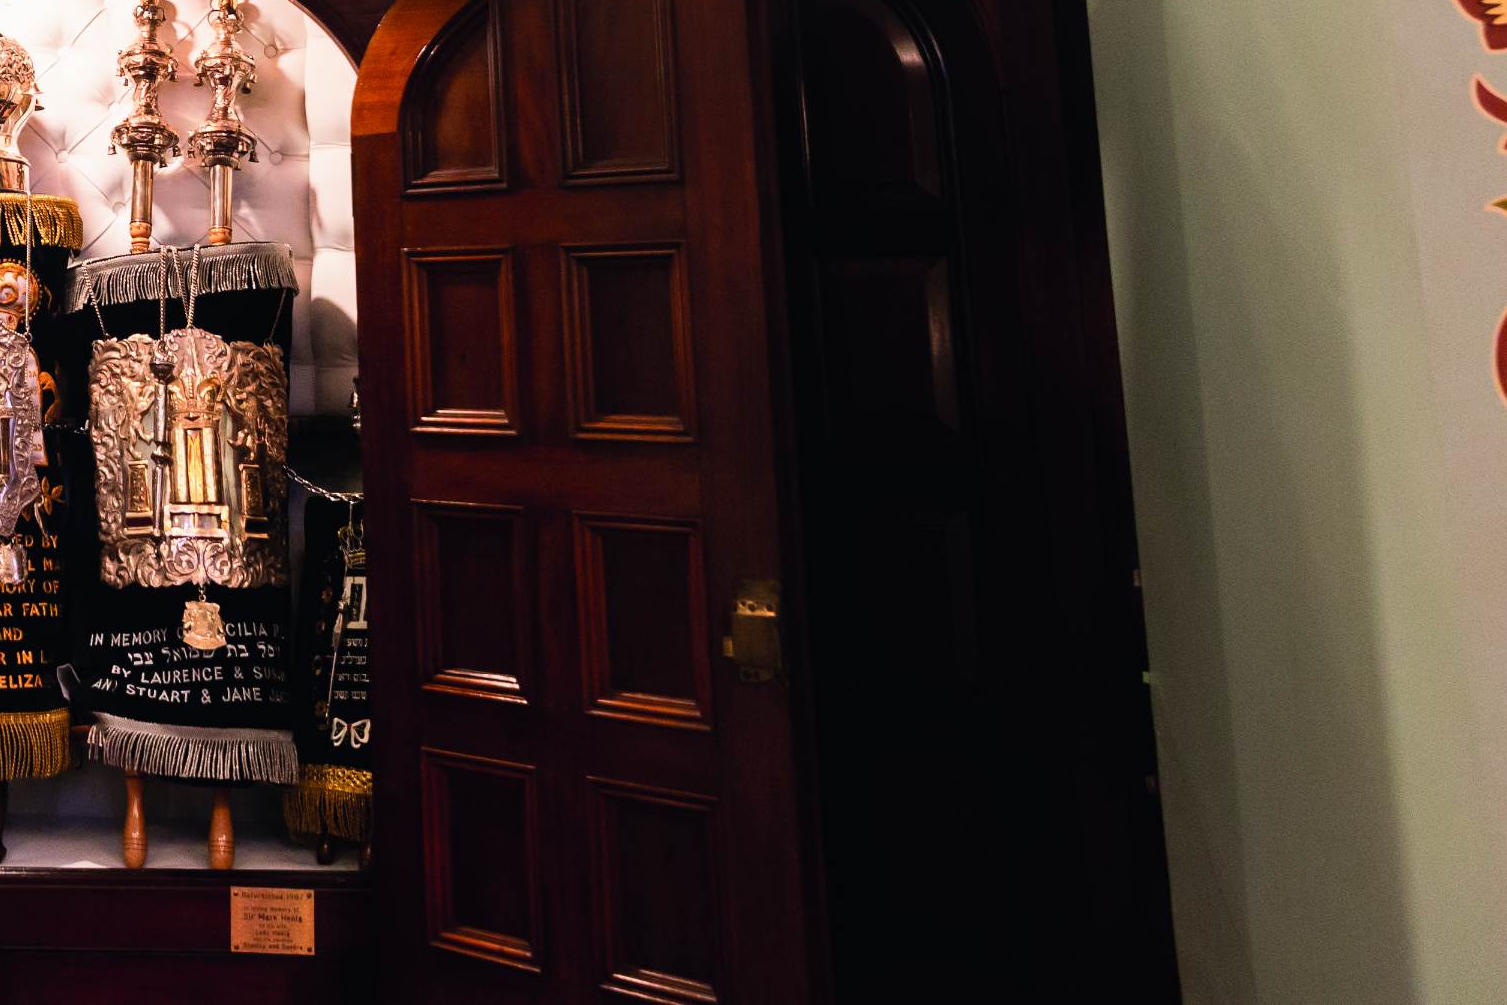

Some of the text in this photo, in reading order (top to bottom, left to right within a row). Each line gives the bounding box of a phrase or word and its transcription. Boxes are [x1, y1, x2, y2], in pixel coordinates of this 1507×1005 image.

[89, 633, 104, 647] IN
[110, 627, 168, 647] MEMORY
[225, 622, 268, 638] CILIA
[16, 650, 33, 665] IN
[111, 664, 131, 679] BY
[141, 666, 223, 685] LAURENCE
[234, 666, 245, 680] &
[126, 684, 191, 703] STUART
[201, 689, 212, 704] &
[222, 686, 262, 703] JANE
